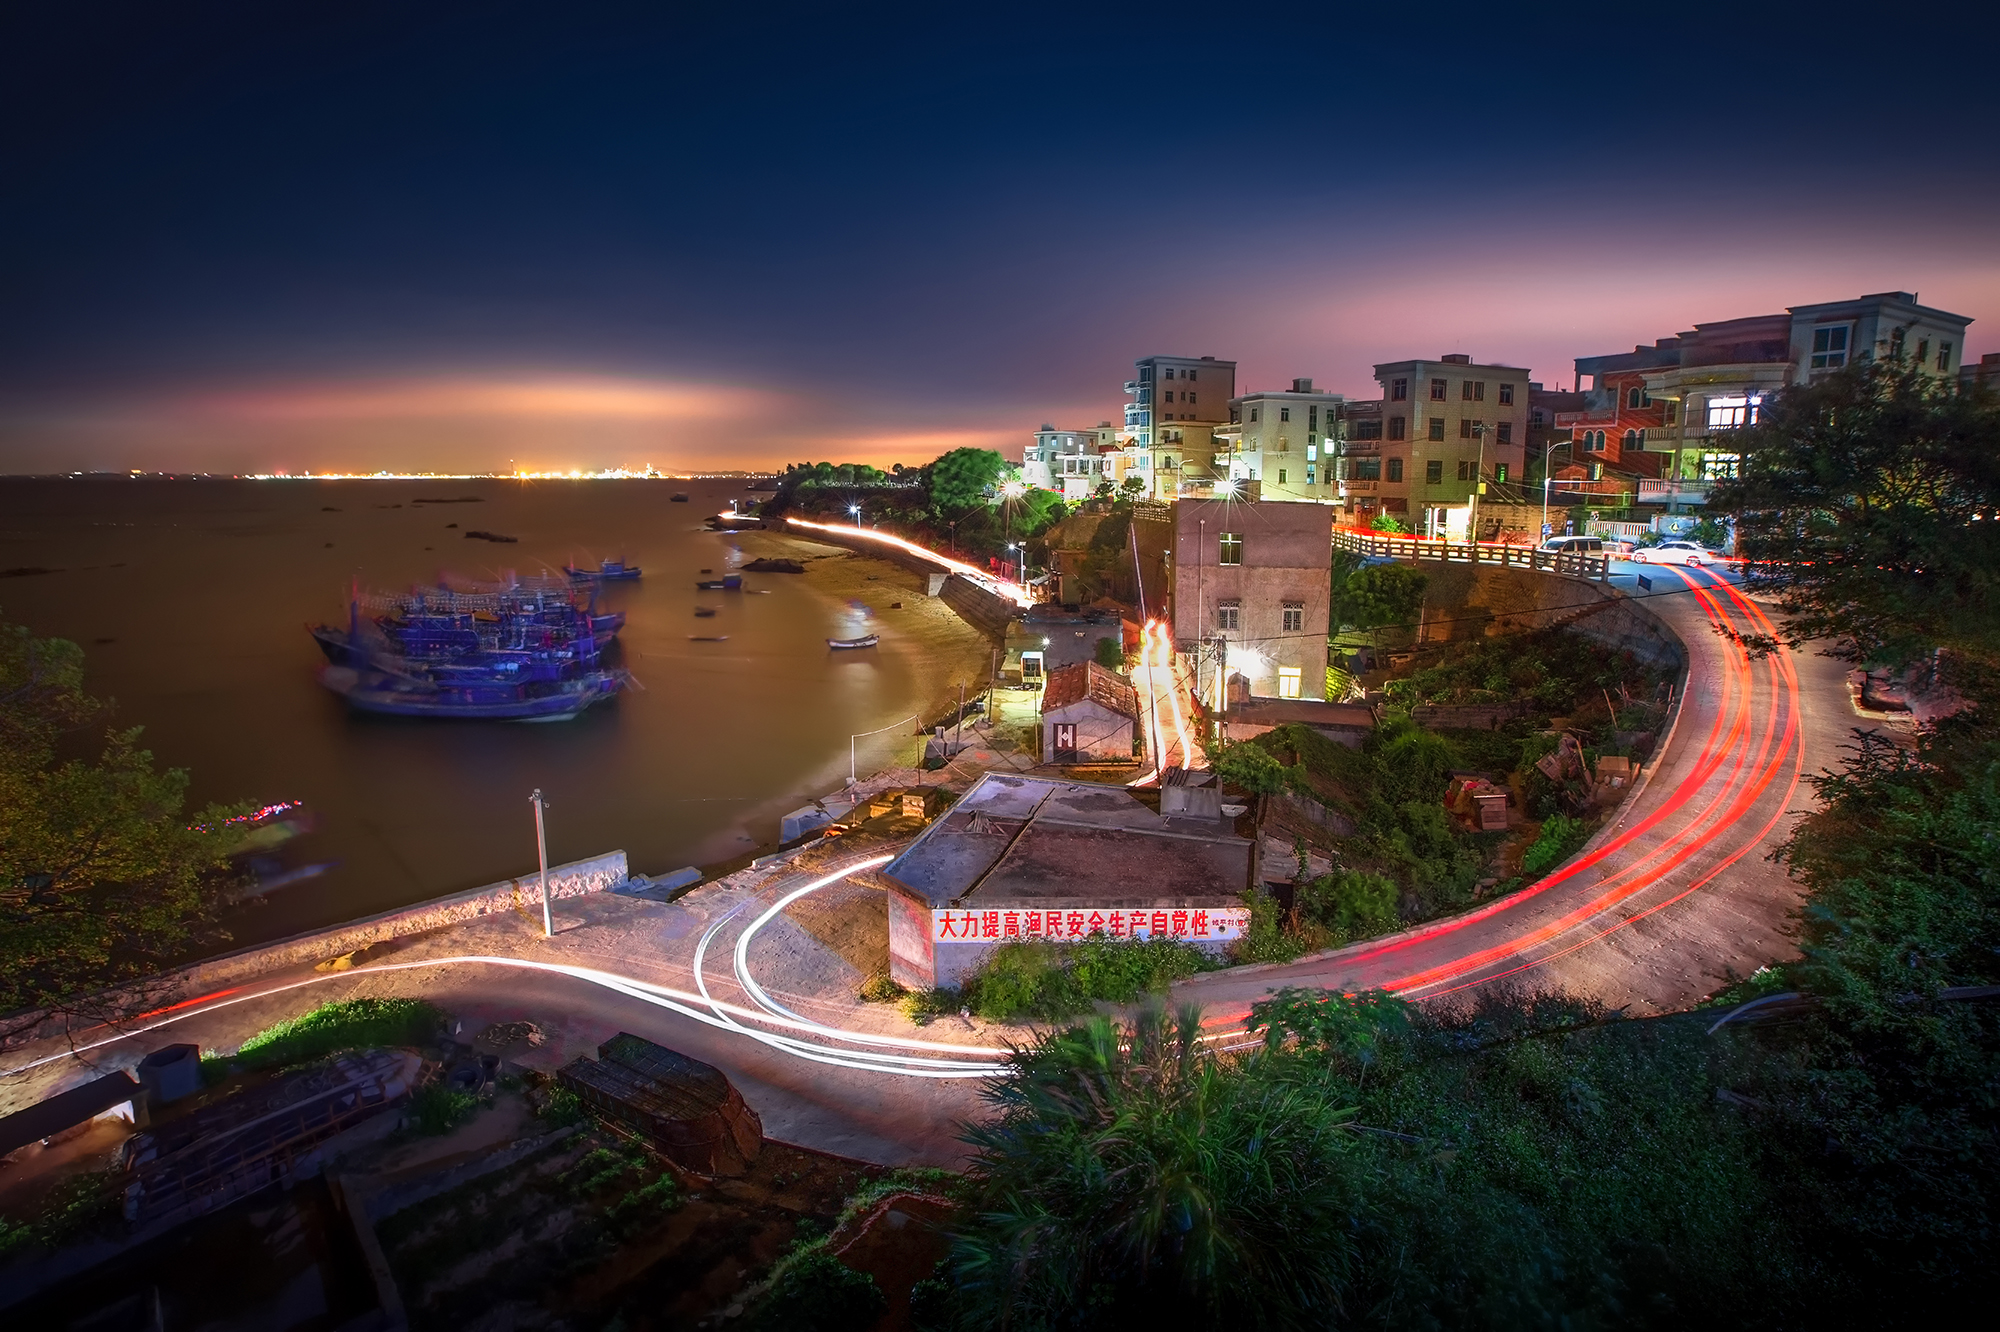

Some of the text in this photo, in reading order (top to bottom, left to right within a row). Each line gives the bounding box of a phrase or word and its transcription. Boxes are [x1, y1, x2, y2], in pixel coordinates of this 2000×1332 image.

[939, 910, 1209, 938] 大力提高渔民安全生产自觉性
